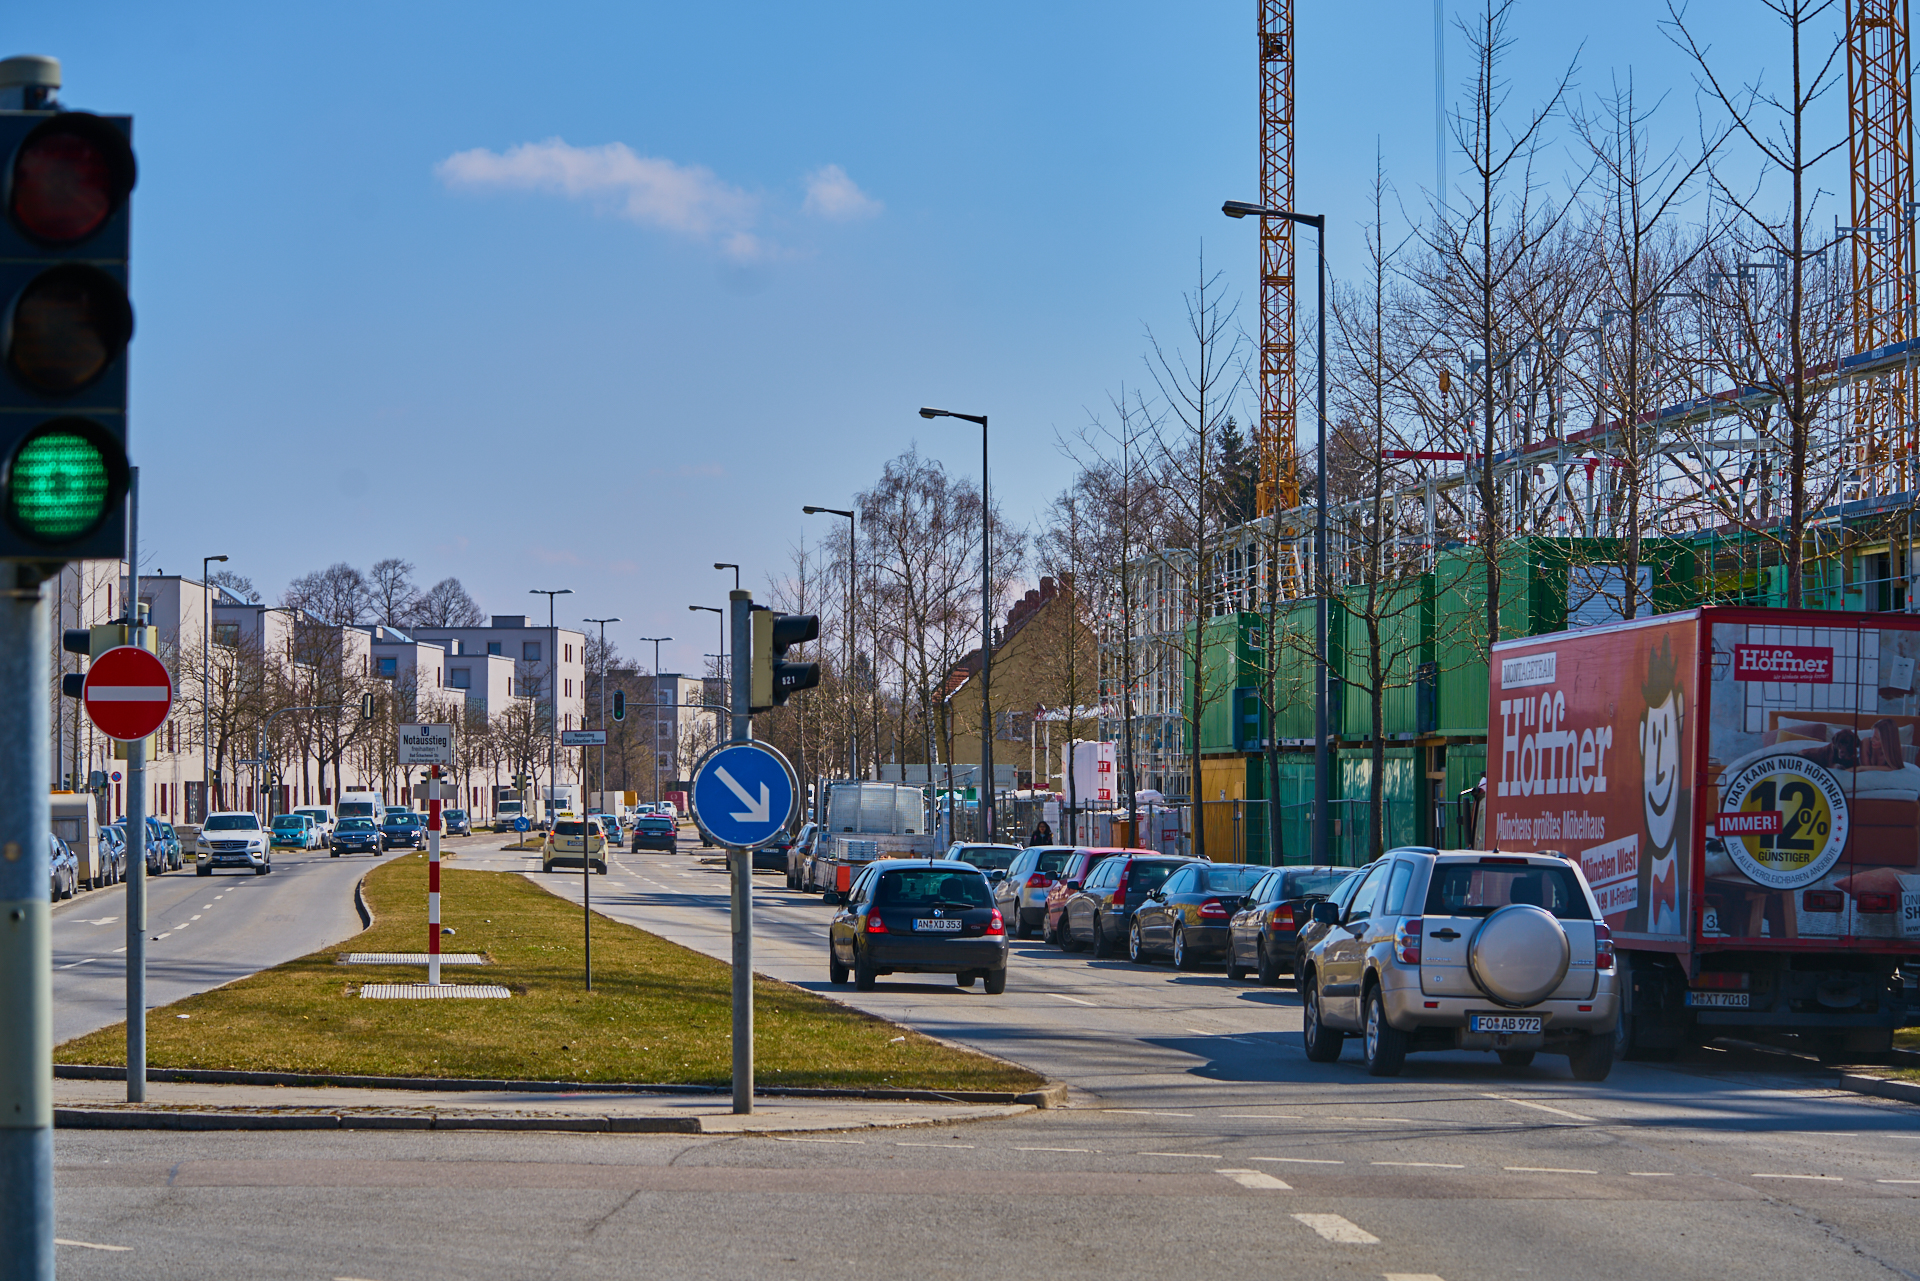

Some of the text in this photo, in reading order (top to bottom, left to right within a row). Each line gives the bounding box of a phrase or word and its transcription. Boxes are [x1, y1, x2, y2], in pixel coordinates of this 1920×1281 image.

[1503, 658, 1554, 683] MONTAGETEAM
[1739, 649, 1828, 673] Höffner
[403, 734, 447, 748] Notausstieg
[1497, 690, 1613, 797] Höffner
[1727, 758, 1844, 811] DAS KANN NUR HÖFFNER!
[1496, 810, 1605, 846] Münchens größtes Möbelhaus
[1719, 816, 1777, 831] IMMER!
[1582, 844, 1636, 884] München West
[1730, 842, 1838, 884] ALS ALLE VERGLEICHBAREN ANGEBOTE
[1758, 849, 1810, 862] GÜNSTIGER
[1610, 885, 1637, 907] M-Freiham
[917, 920, 929, 929] AN
[933, 920, 944, 929] XD
[946, 920, 961, 929] 353
[1691, 993, 1748, 1006] M XT 7018
[1478, 1017, 1539, 1030] FO AB 972
